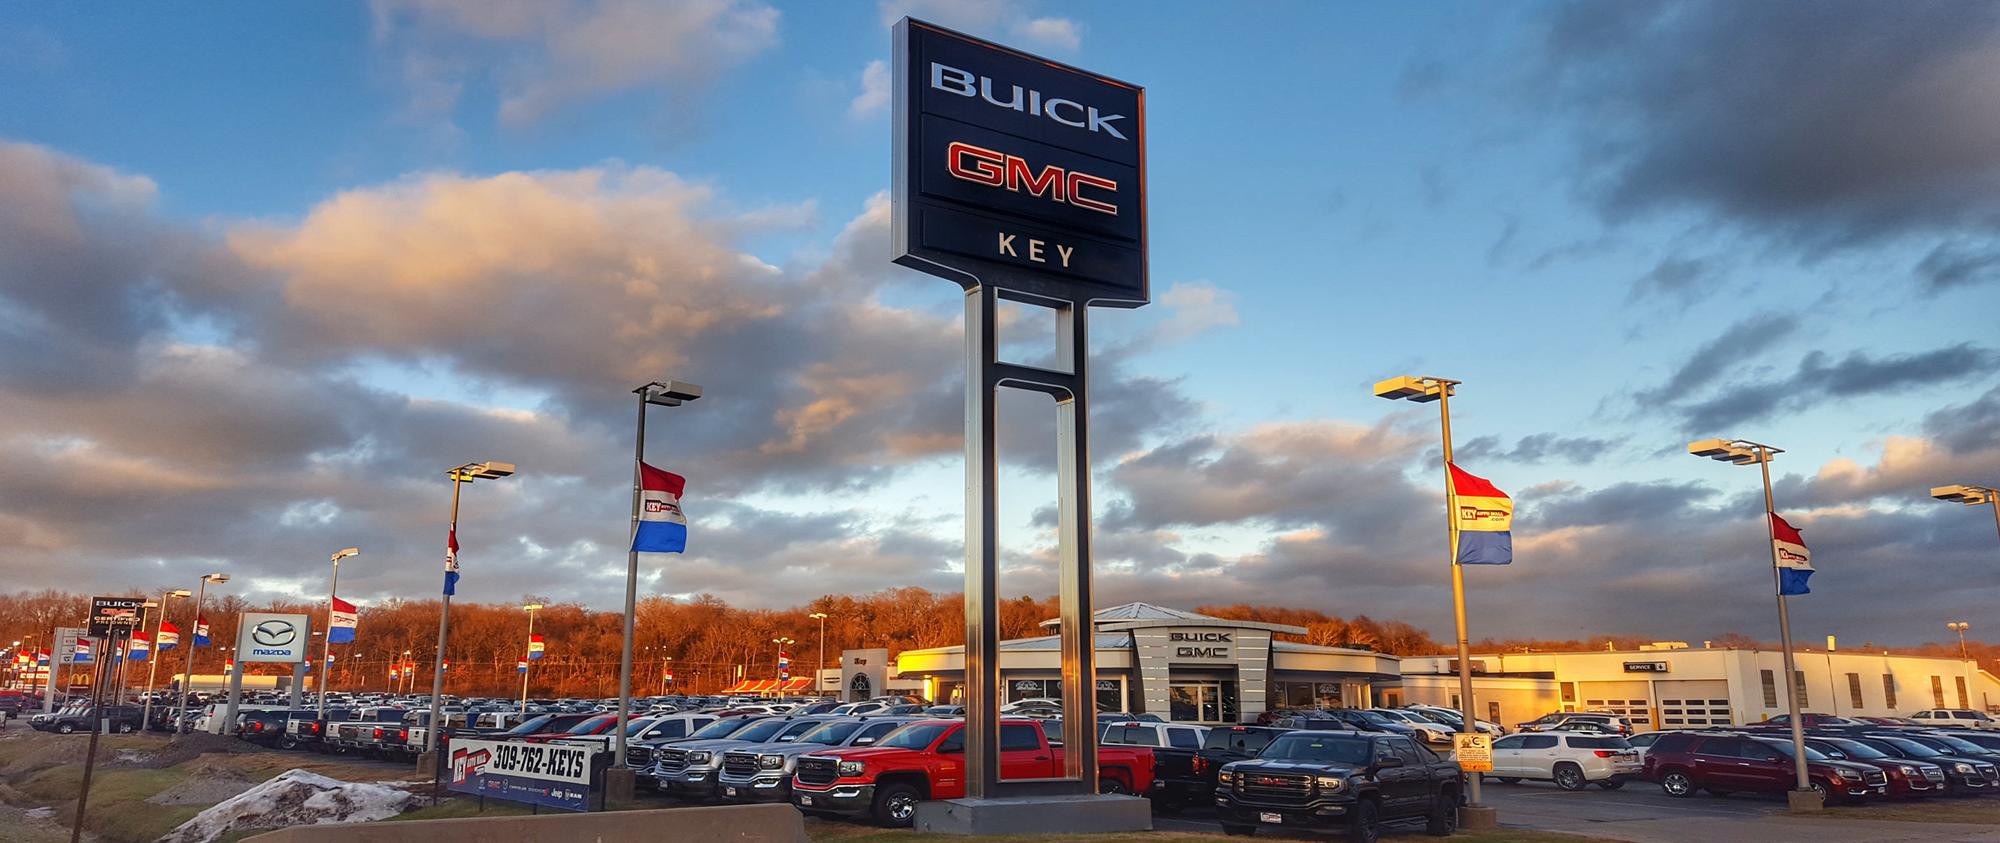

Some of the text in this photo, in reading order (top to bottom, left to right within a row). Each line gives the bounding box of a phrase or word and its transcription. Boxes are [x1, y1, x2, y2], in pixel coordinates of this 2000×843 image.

[930, 61, 1129, 140] BUICK
[948, 141, 1118, 215] GMC
[999, 232, 1074, 268] KEY
[646, 502, 661, 512] KEY
[1461, 509, 1477, 519] KEY
[1169, 633, 1232, 642] BUICK
[1176, 647, 1228, 658] GMC
[494, 744, 585, 778] 309-762-KEYS
[1257, 777, 1288, 785] GMC
[551, 787, 563, 799] Jeep
